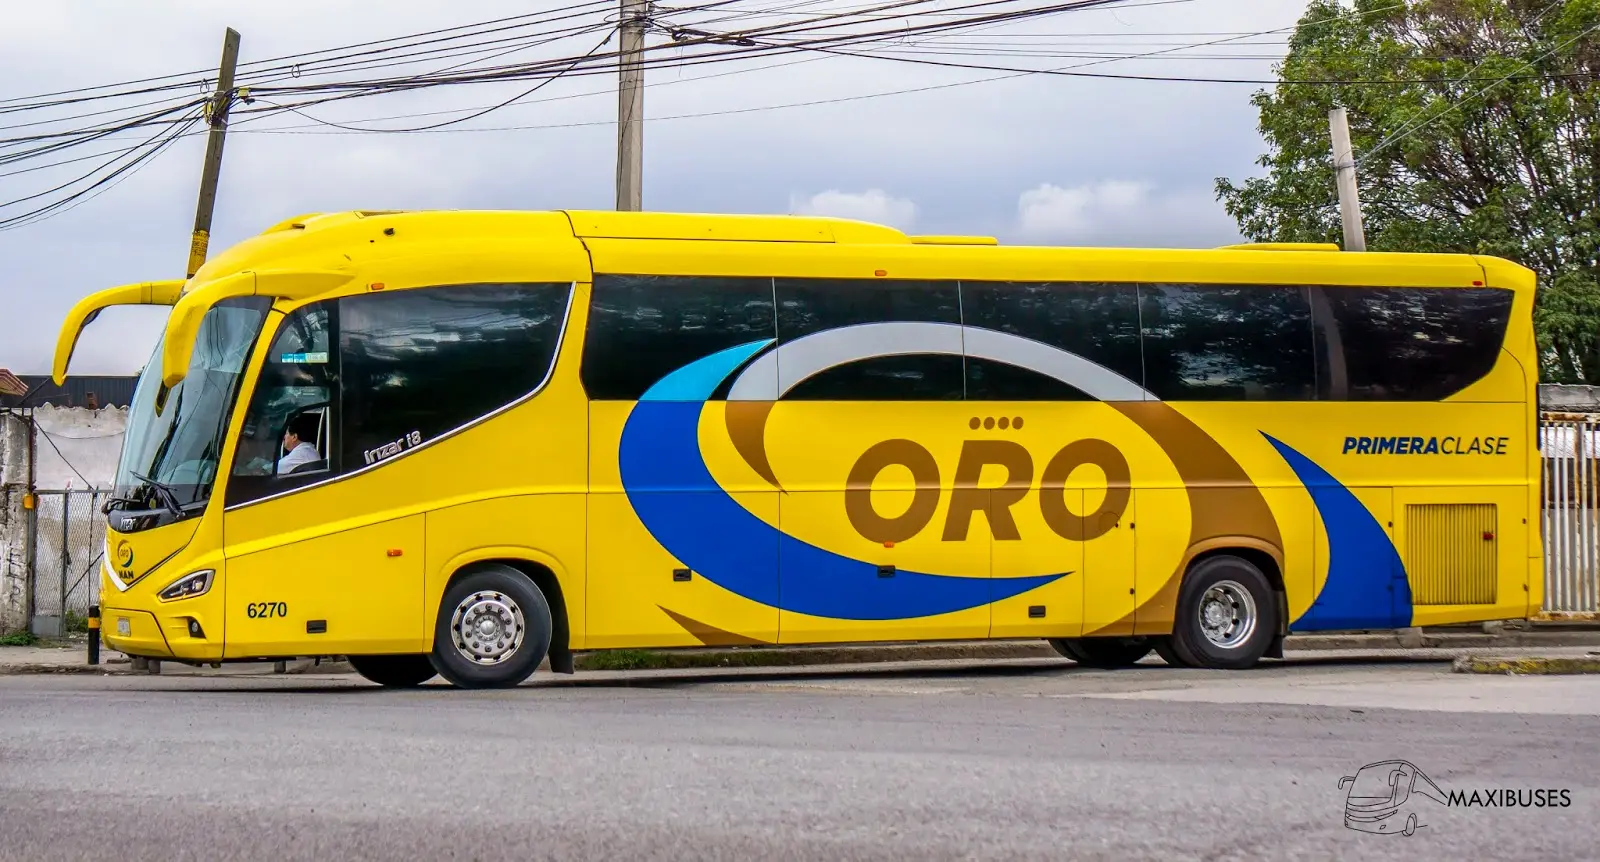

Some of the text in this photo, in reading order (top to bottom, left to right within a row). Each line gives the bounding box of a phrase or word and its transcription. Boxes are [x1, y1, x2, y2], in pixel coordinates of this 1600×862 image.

[406, 430, 421, 447] i8
[845, 438, 1131, 543] ORO
[247, 602, 287, 618] 6270
